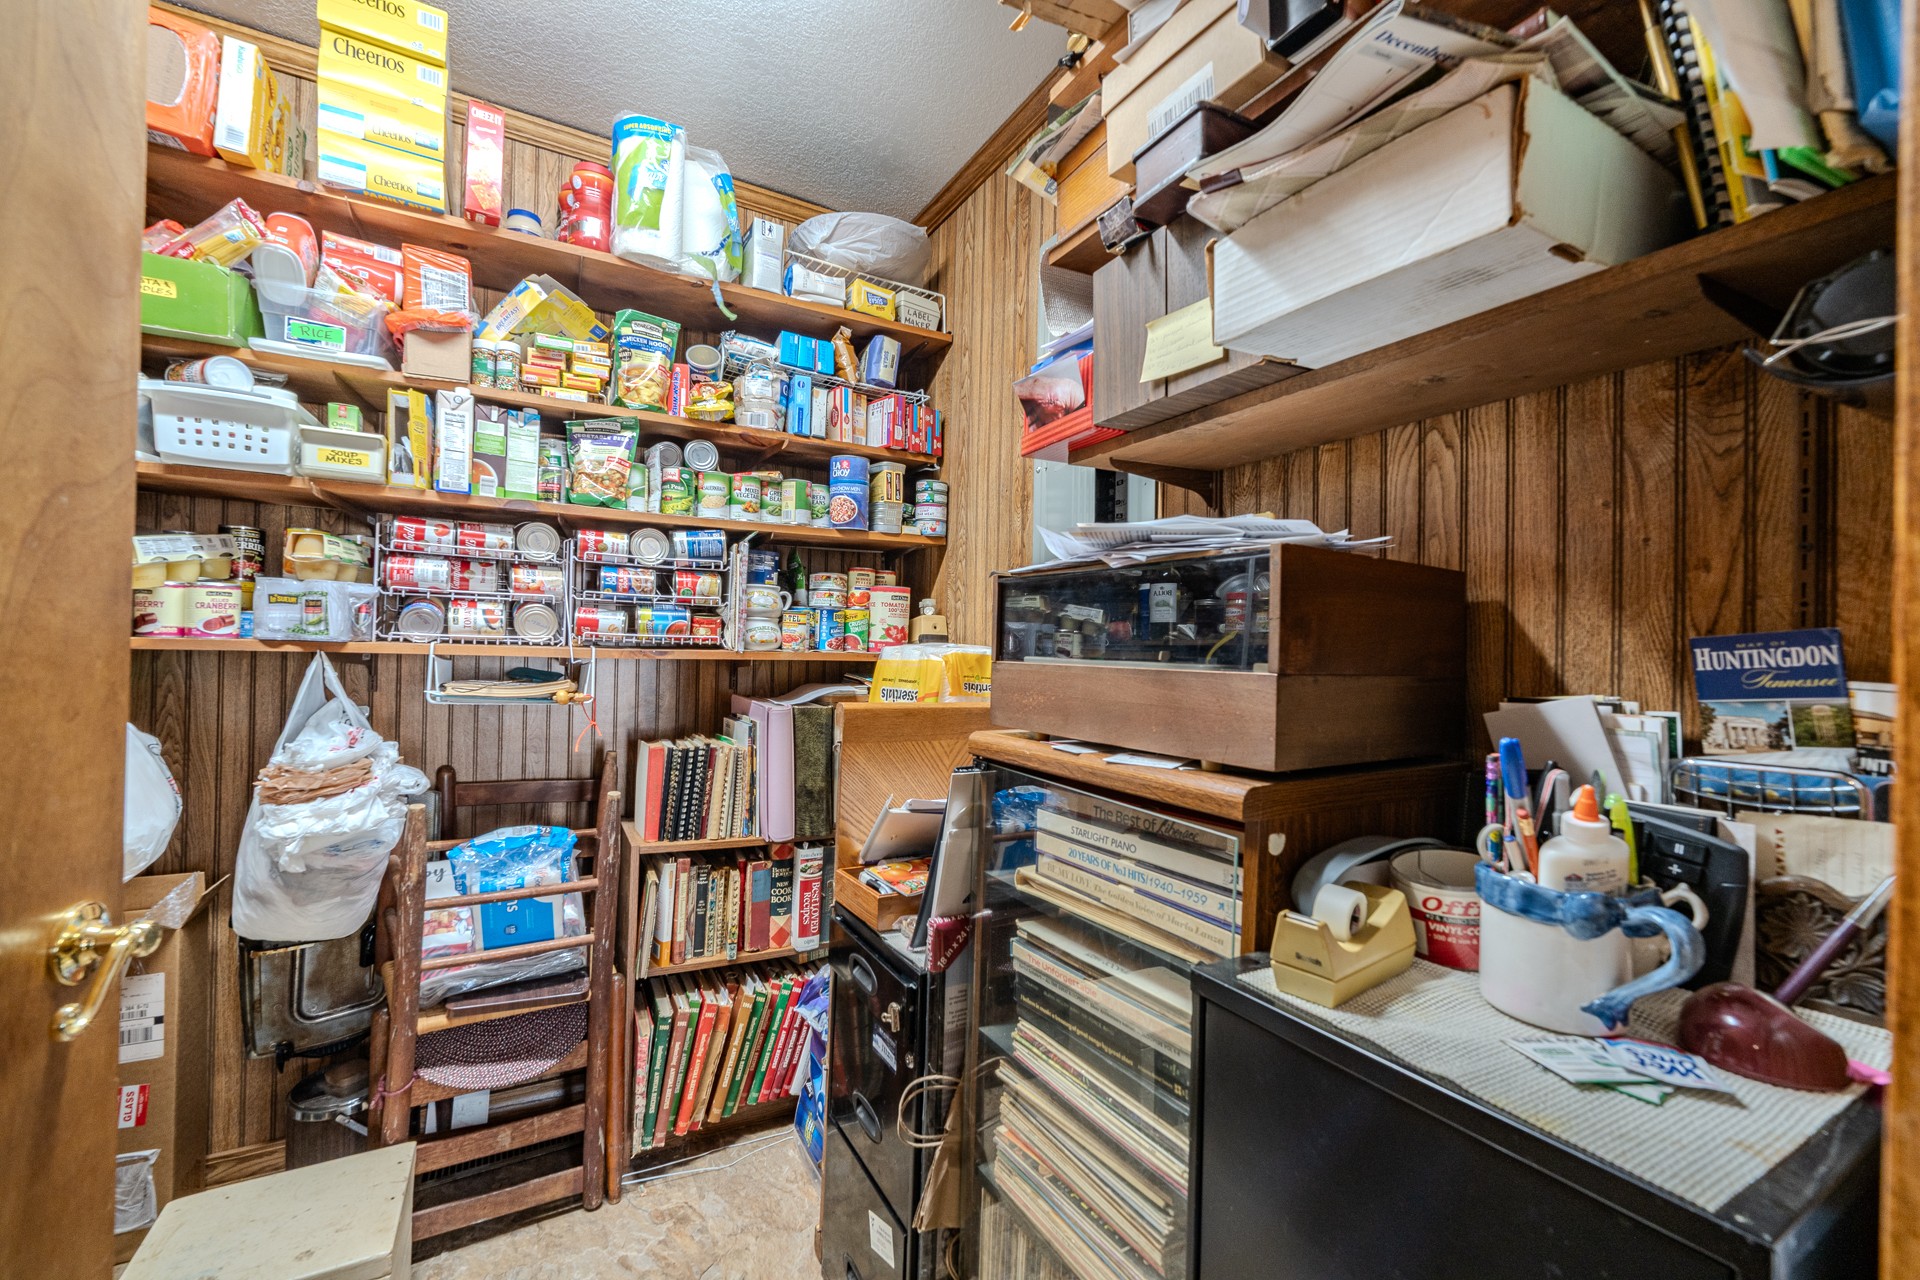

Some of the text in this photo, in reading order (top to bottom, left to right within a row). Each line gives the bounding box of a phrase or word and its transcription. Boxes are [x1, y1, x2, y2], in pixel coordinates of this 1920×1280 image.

[356, 0, 405, 18] erios
[333, 37, 405, 73] Cheerios
[1375, 29, 1454, 63] December
[373, 174, 413, 194] Cheerios
[496, 305, 520, 331] BREAKFAST
[904, 317, 931, 330] MAKER
[907, 309, 932, 322] LABEL
[299, 325, 334, 340] RICE
[671, 394, 680, 416] WHEA
[326, 455, 362, 466] MIXES
[329, 449, 359, 459] SOUP
[832, 468, 850, 478] CHOY
[833, 461, 840, 470] LA
[195, 602, 239, 610] CRANBERRY
[1693, 644, 1840, 671] HUNTINGDON
[1740, 668, 1840, 690] Tennessee
[1092, 804, 1200, 843] The Best of Liberace
[1070, 826, 1138, 854] STARLIGHT PIANO
[1067, 847, 1078, 858] 20
[1076, 848, 1100, 868] YEARS
[1100, 856, 1112, 870] OF
[771, 887, 792, 896] COOK
[771, 895, 792, 904] BOOK
[802, 891, 811, 926] Recipes
[810, 904, 820, 934] LOVED
[1194, 927, 1225, 947] Lanza
[937, 956, 948, 968] 18
[944, 948, 954, 958] in
[956, 930, 967, 943] 24
[1026, 953, 1098, 998] The Unforgettable
[123, 1090, 135, 1123] GLASS
